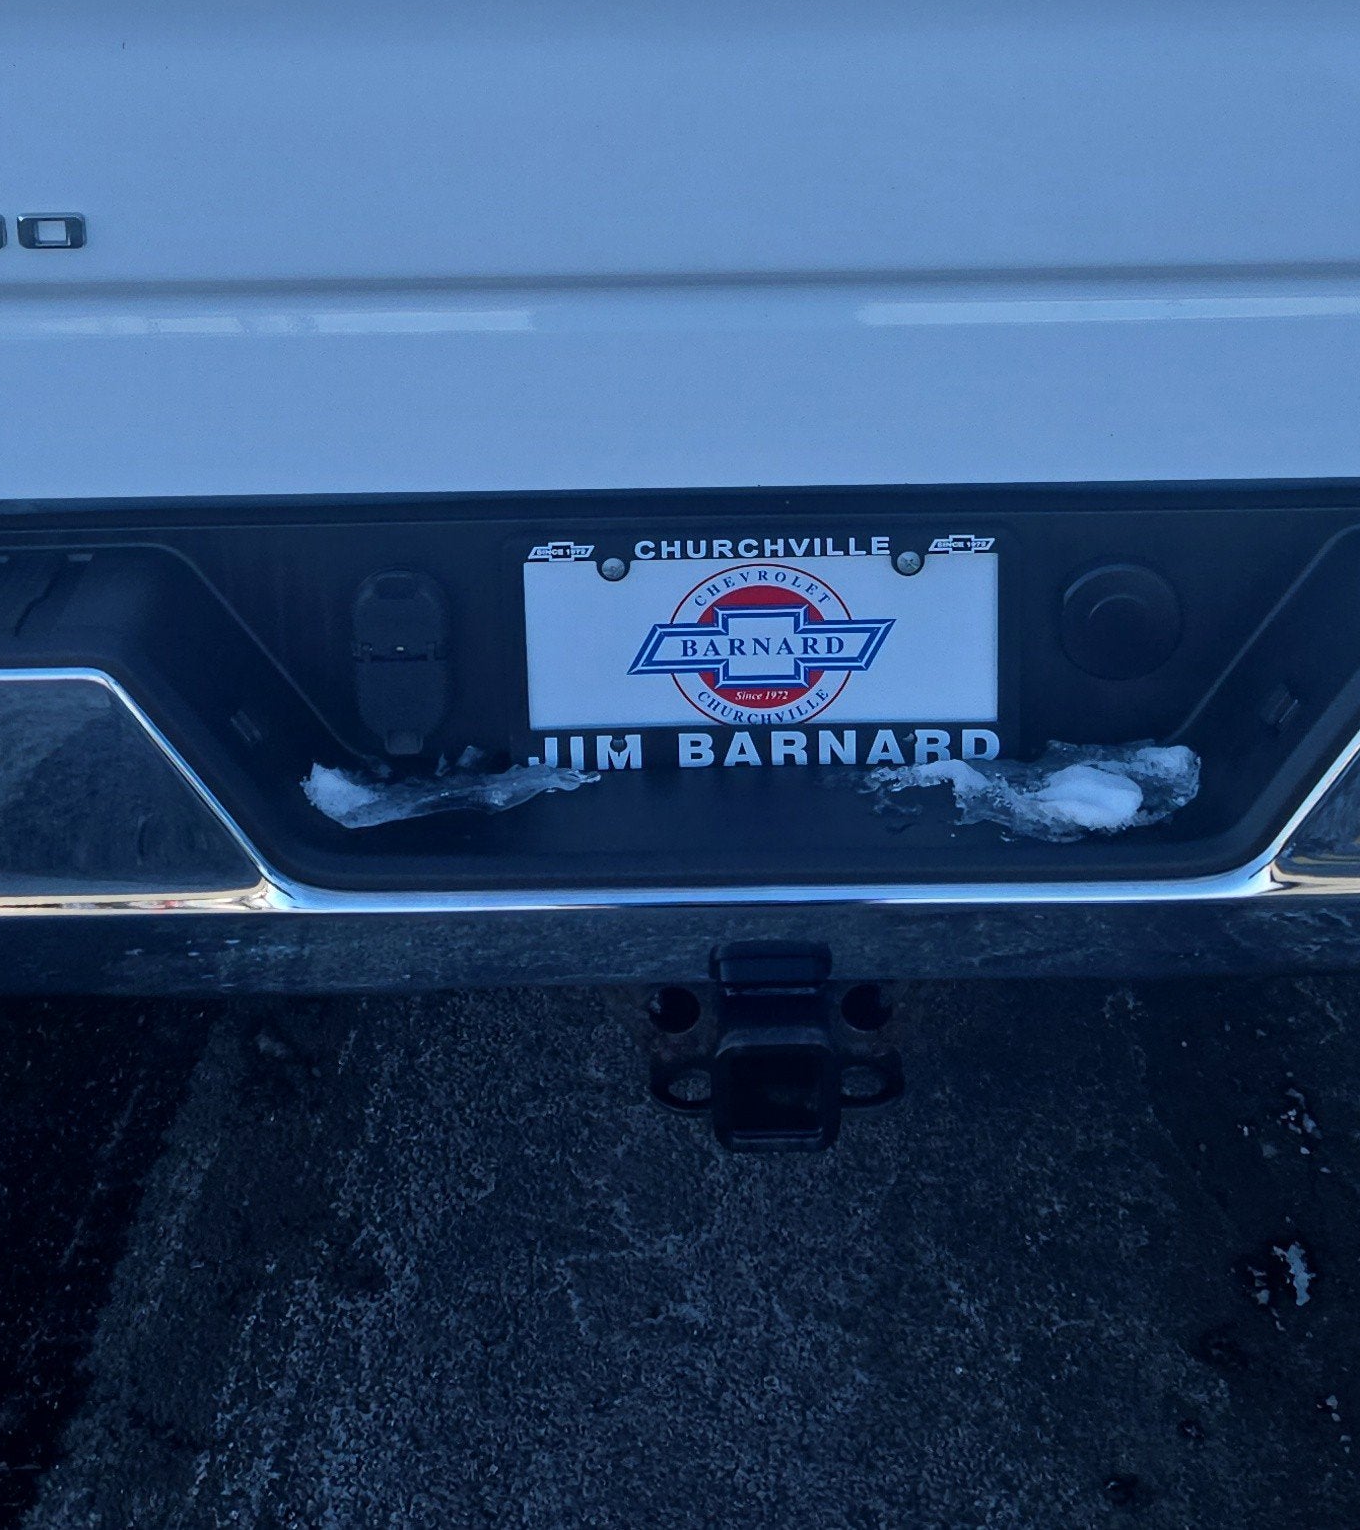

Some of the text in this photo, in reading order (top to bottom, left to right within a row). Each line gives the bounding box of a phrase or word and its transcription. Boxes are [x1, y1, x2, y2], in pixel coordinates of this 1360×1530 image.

[634, 536, 891, 559] CHURCHVILLE
[694, 570, 831, 607] CHEVROLET
[680, 636, 845, 658] BARNARD
[697, 688, 830, 725] CHURCHVILLE
[734, 690, 789, 701] Since 1972
[528, 728, 1001, 770] JIM BARNARD
